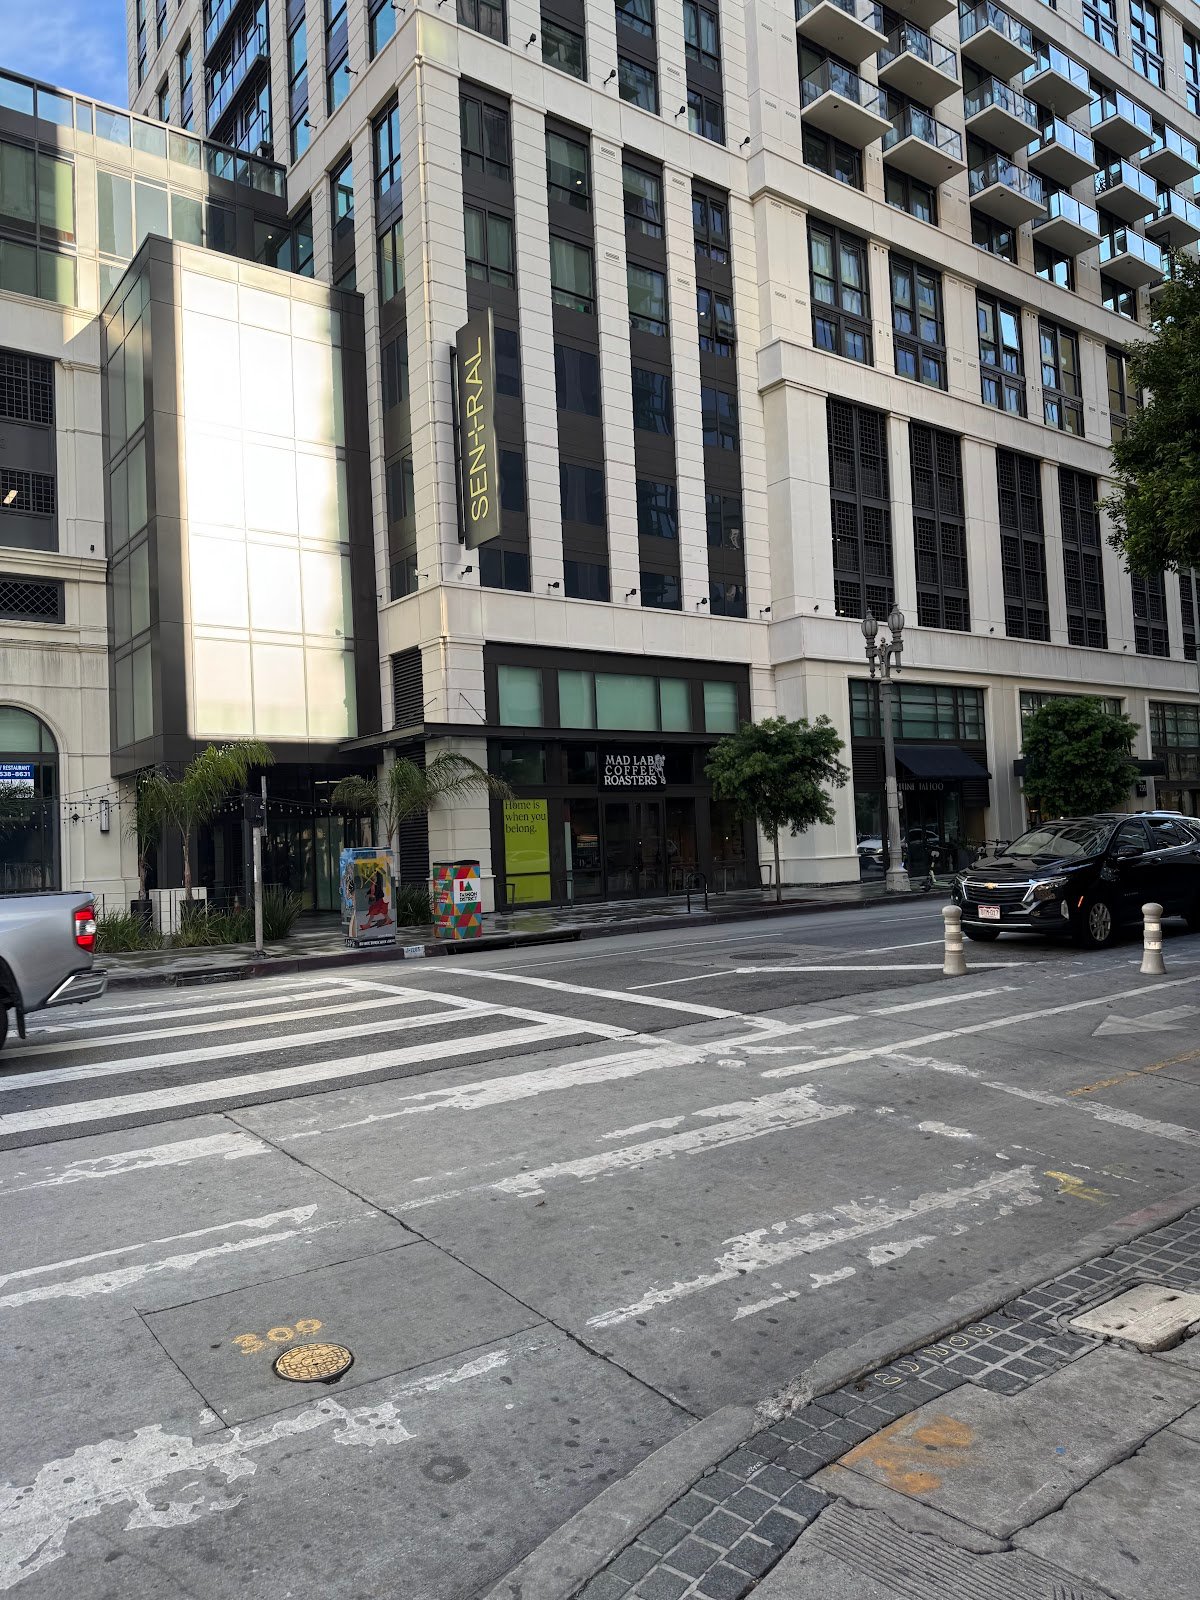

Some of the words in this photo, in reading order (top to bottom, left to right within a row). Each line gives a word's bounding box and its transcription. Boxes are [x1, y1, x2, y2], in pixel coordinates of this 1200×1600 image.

[605, 755, 630, 765] MAD
[633, 755, 654, 765] LAB
[605, 765, 655, 775] COFFEE
[604, 775, 657, 785] ROASTERS
[504, 800, 531, 810] Home
[533, 800, 541, 810] is
[505, 812, 530, 821] when
[531, 813, 546, 822] you
[505, 823, 537, 834] belong.
[459, 881, 473, 891] LA
